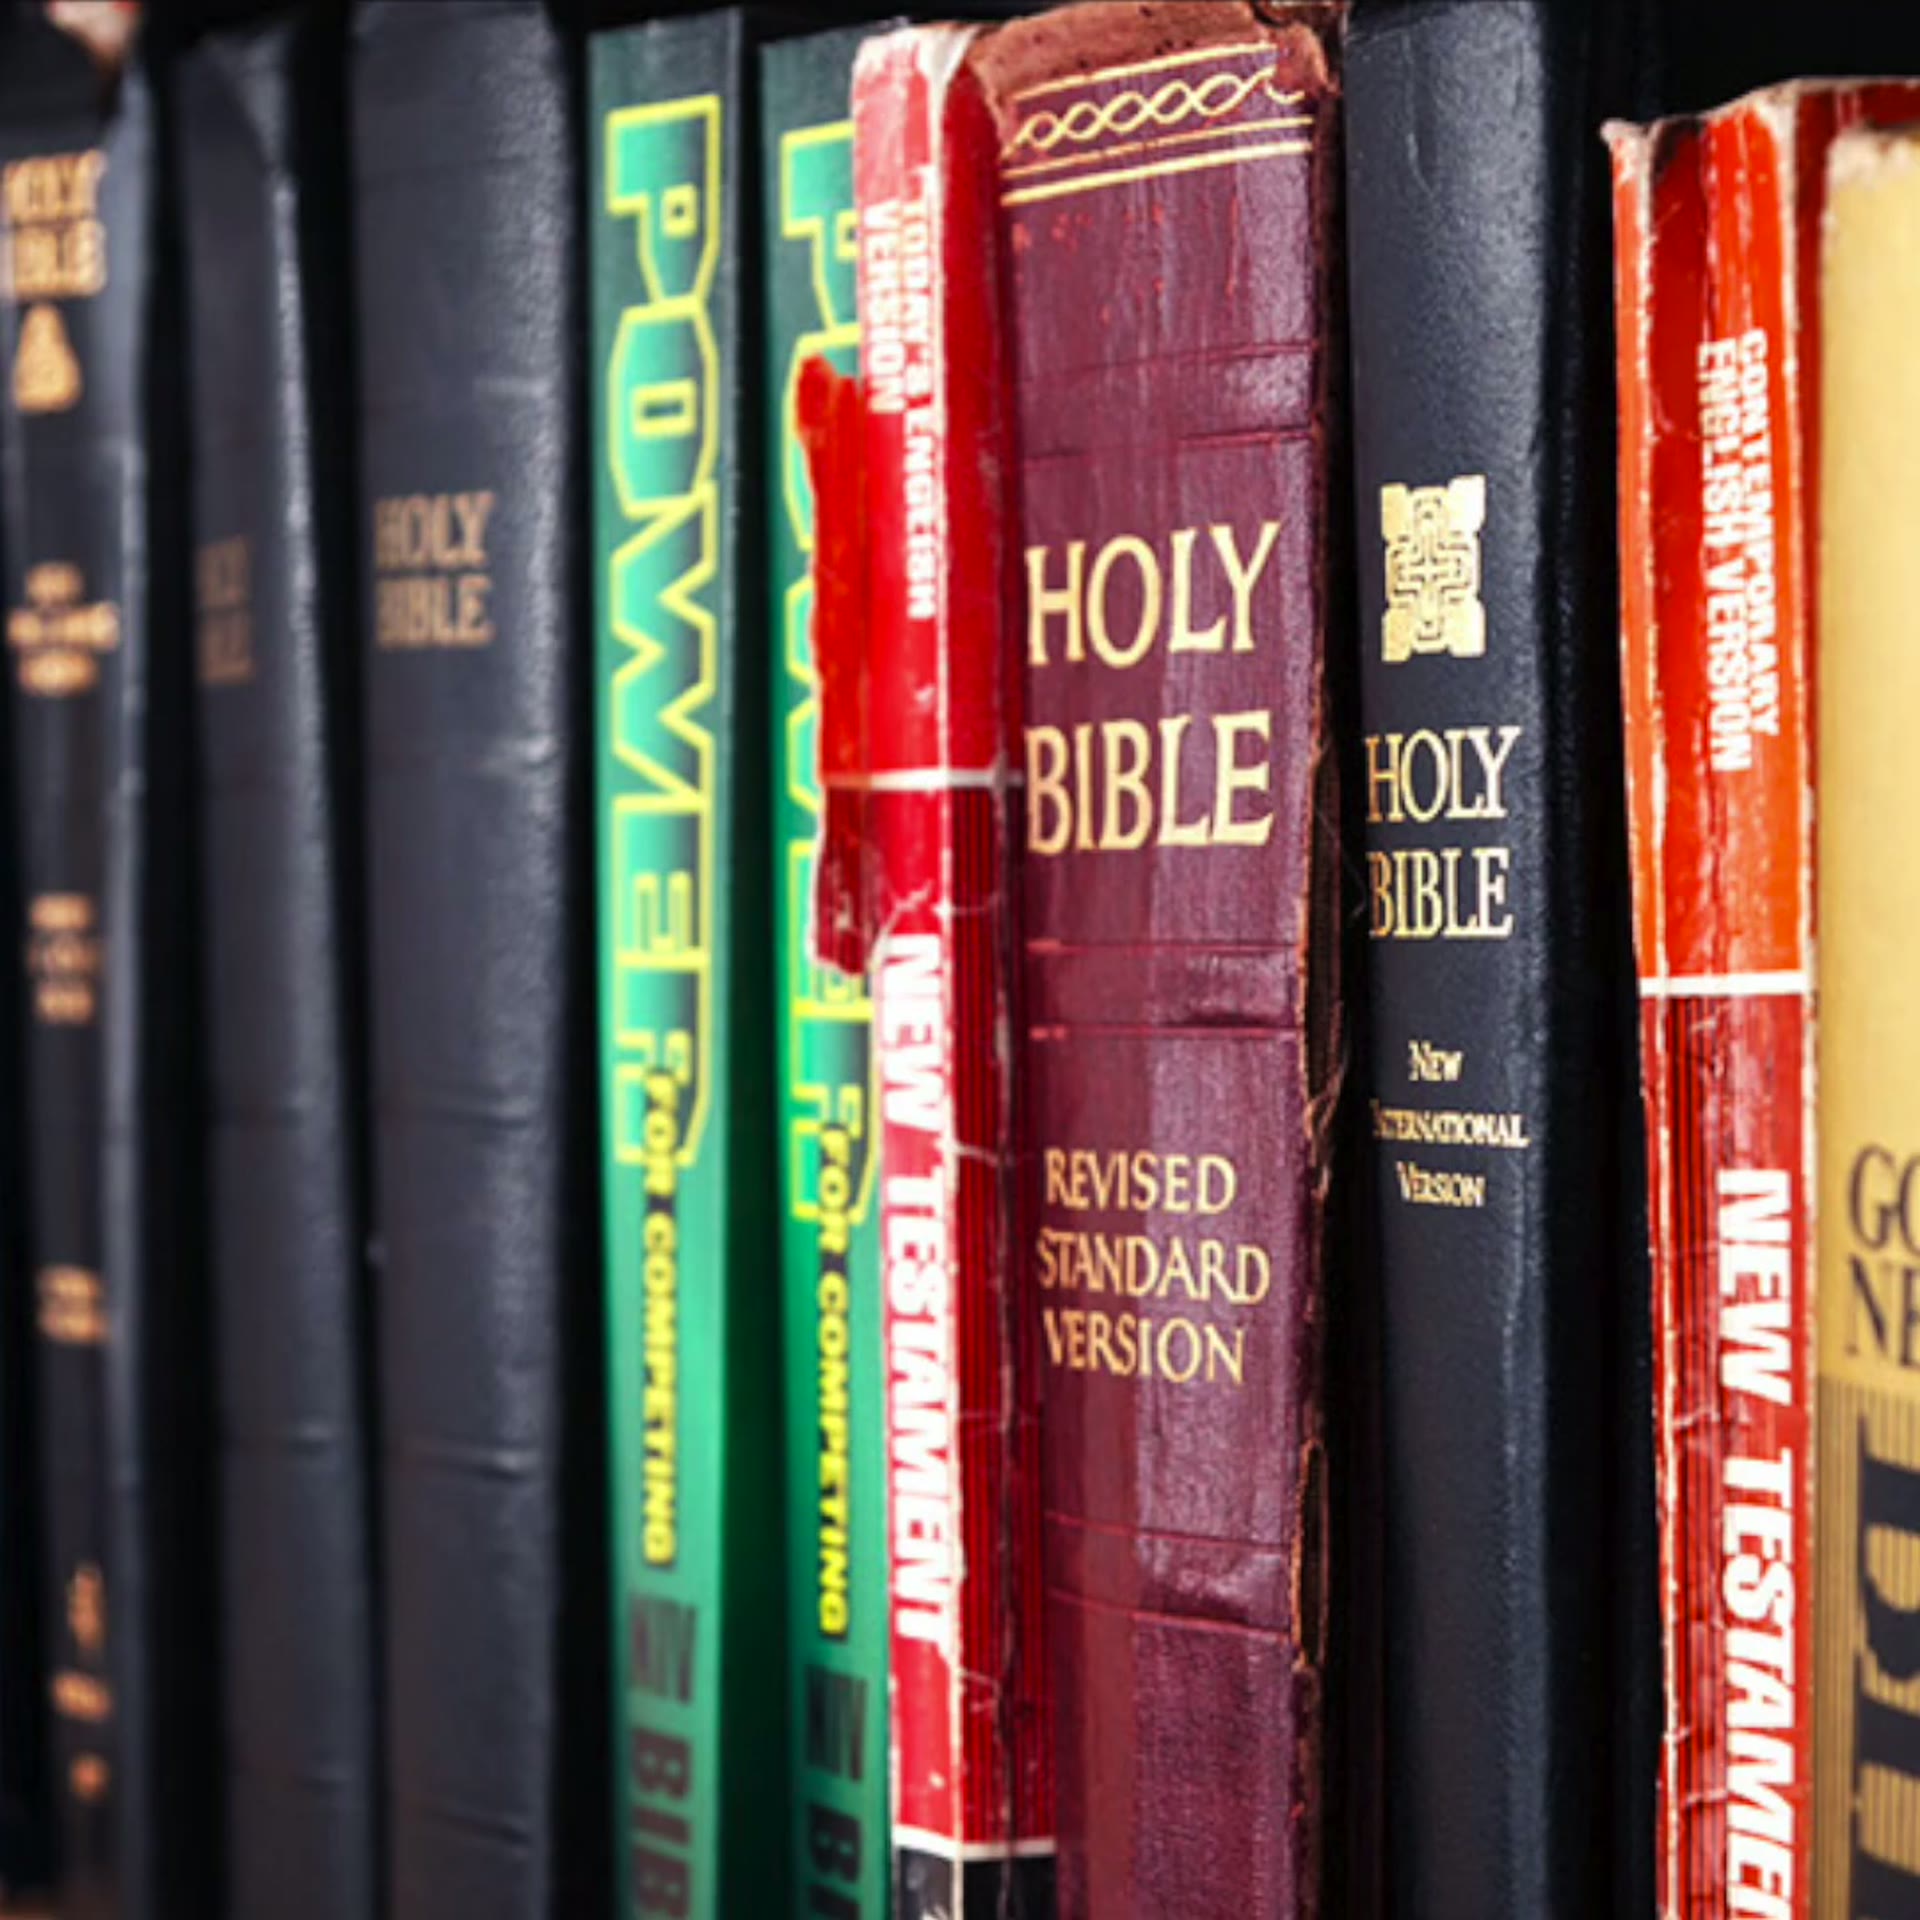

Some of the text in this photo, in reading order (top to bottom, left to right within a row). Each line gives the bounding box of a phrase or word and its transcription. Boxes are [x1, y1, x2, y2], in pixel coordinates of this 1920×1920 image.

[862, 199, 906, 414] VERSION
[374, 491, 496, 569] HOLY
[902, 405, 942, 620] ENGLISH
[1697, 337, 1745, 548] ENGLISH
[1024, 521, 1282, 669] HOLY
[1740, 328, 1781, 738] CONTEMPORARY
[607, 95, 720, 1167] POWER
[1708, 558, 1754, 773] VERSION
[1023, 709, 1275, 856] BIBLE
[1365, 725, 1522, 823] HOLY
[1366, 846, 1514, 938] BIBLE
[641, 1068, 679, 1196] FOR
[818, 1127, 850, 1253] FOR
[1045, 1146, 1238, 1216] REVISED
[883, 932, 962, 1660] NEW TESTAMENT
[1037, 1226, 1271, 1306] STANDARD
[1043, 1306, 1245, 1385] VERSION
[1718, 1168, 1793, 1405] NEW
[640, 1210, 680, 1567] COMPETING
[818, 1270, 850, 1638] COMPETING
